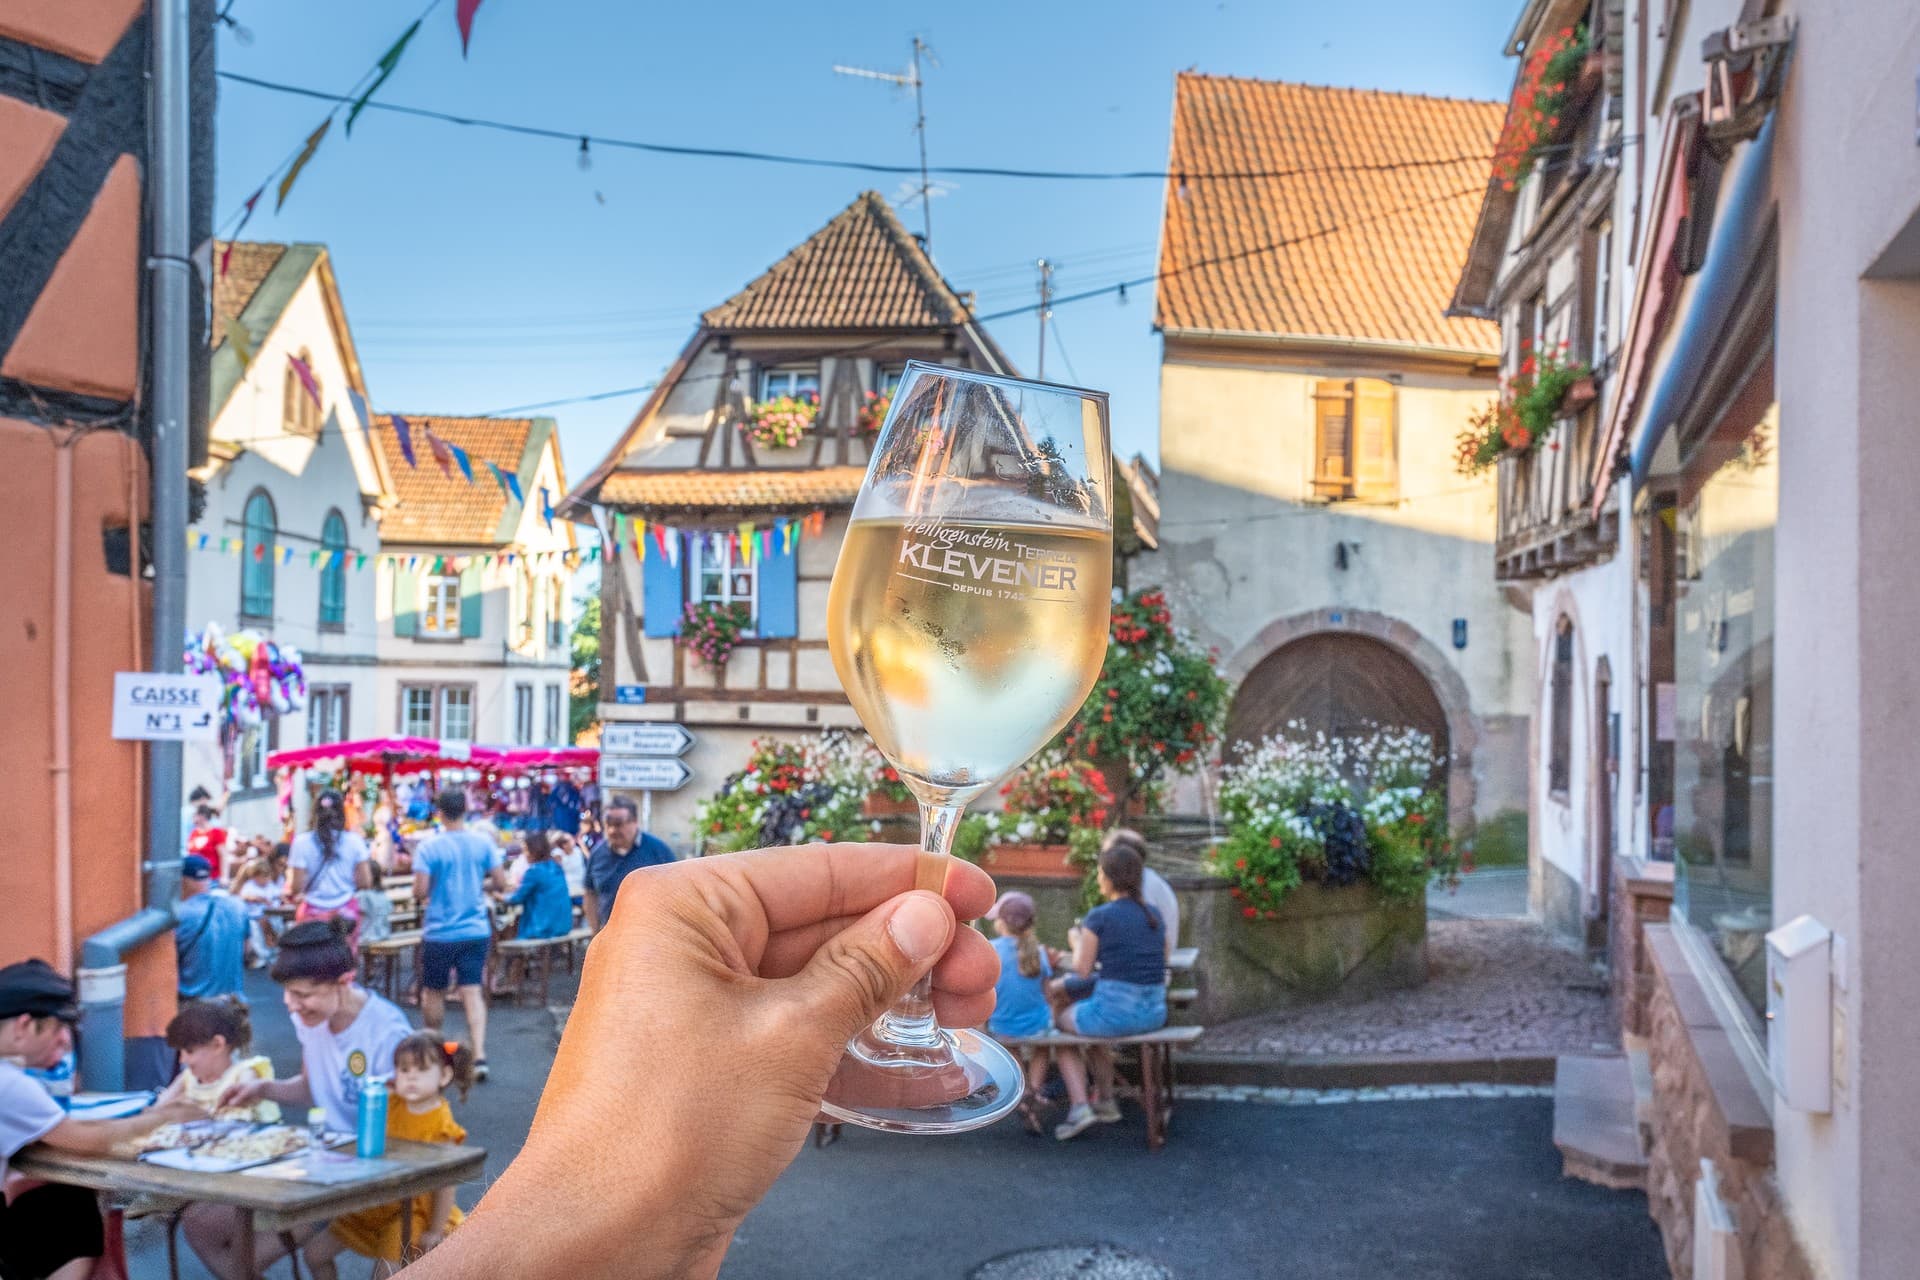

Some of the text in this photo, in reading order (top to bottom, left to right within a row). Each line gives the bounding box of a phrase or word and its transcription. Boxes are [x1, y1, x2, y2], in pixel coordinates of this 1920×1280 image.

[903, 514, 1010, 552] Heiligenstein
[898, 540, 1077, 591] KLEVENER
[952, 583, 993, 597] DEPUIS
[130, 686, 201, 703] CAISSE
